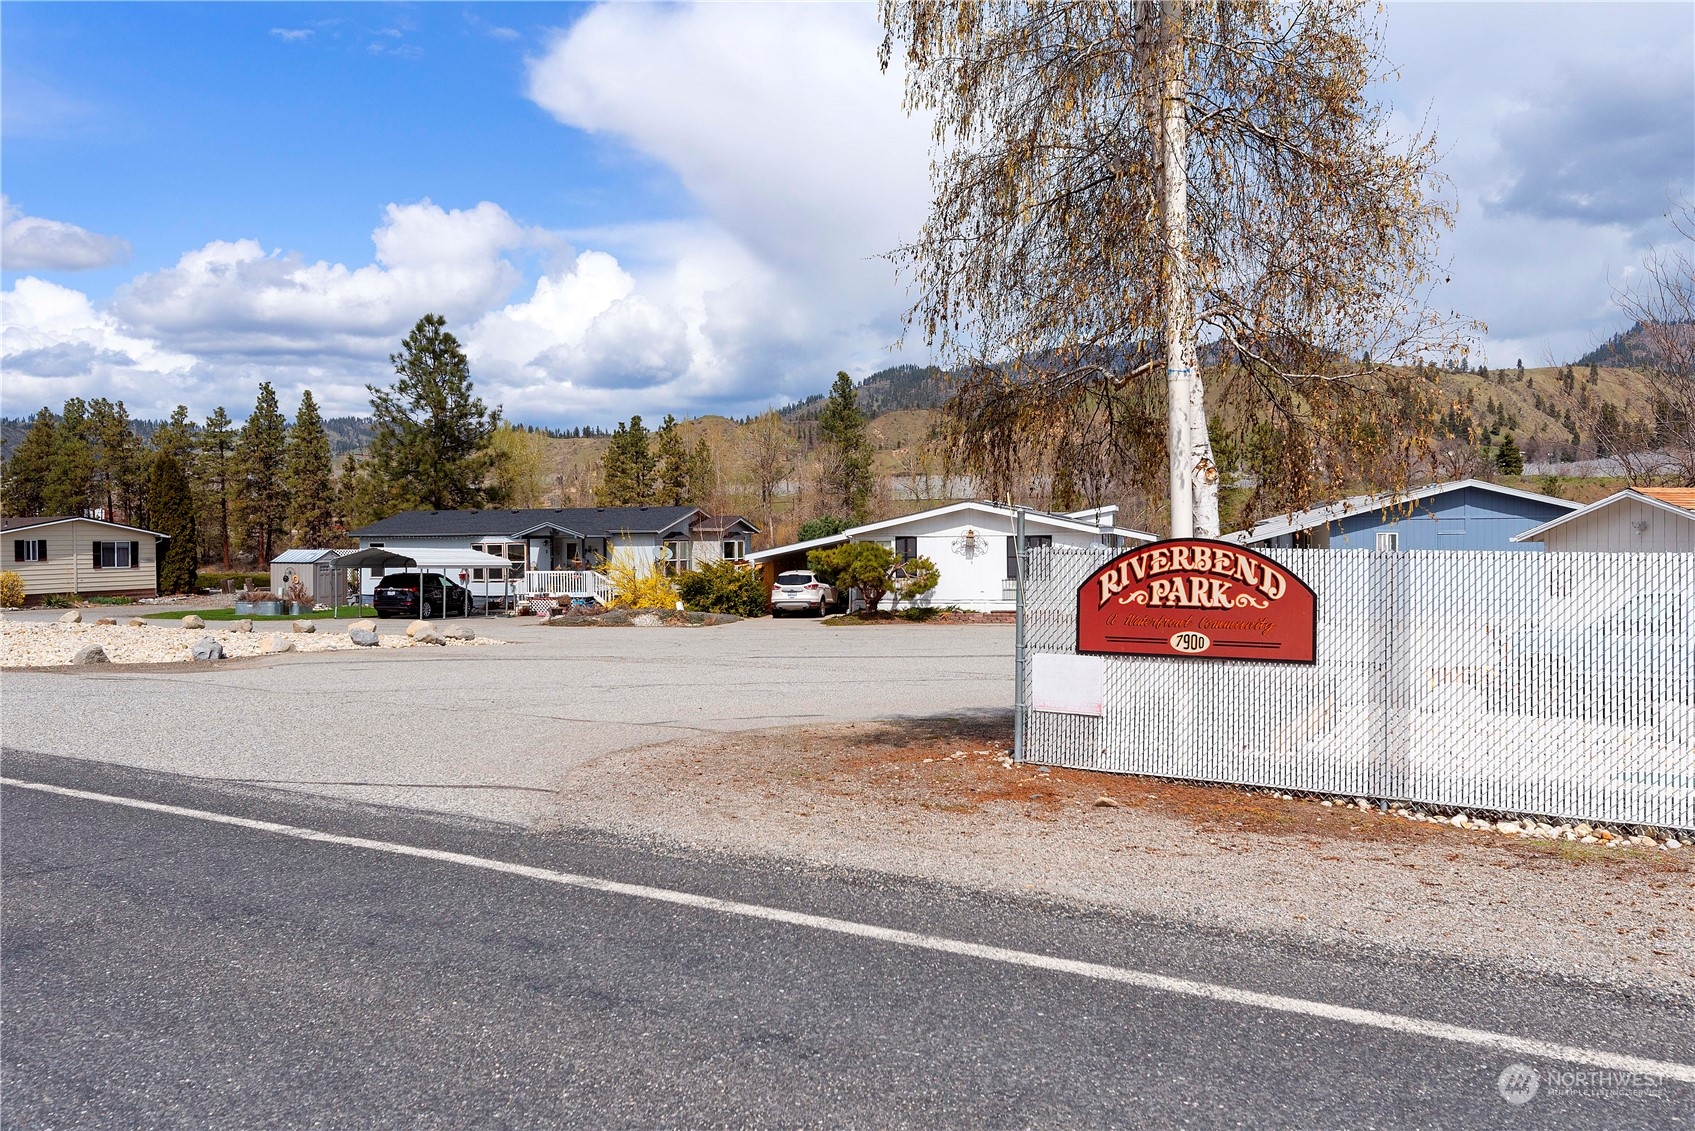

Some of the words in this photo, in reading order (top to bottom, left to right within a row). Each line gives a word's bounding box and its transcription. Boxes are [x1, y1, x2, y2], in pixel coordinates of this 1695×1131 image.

[1098, 546, 1287, 606] RIVERBEND
[1149, 577, 1235, 608] PARK
[1106, 614, 1117, 624] A
[1124, 614, 1193, 629] Waterfront
[1198, 616, 1275, 633] Community
[1176, 633, 1205, 651] 7900
